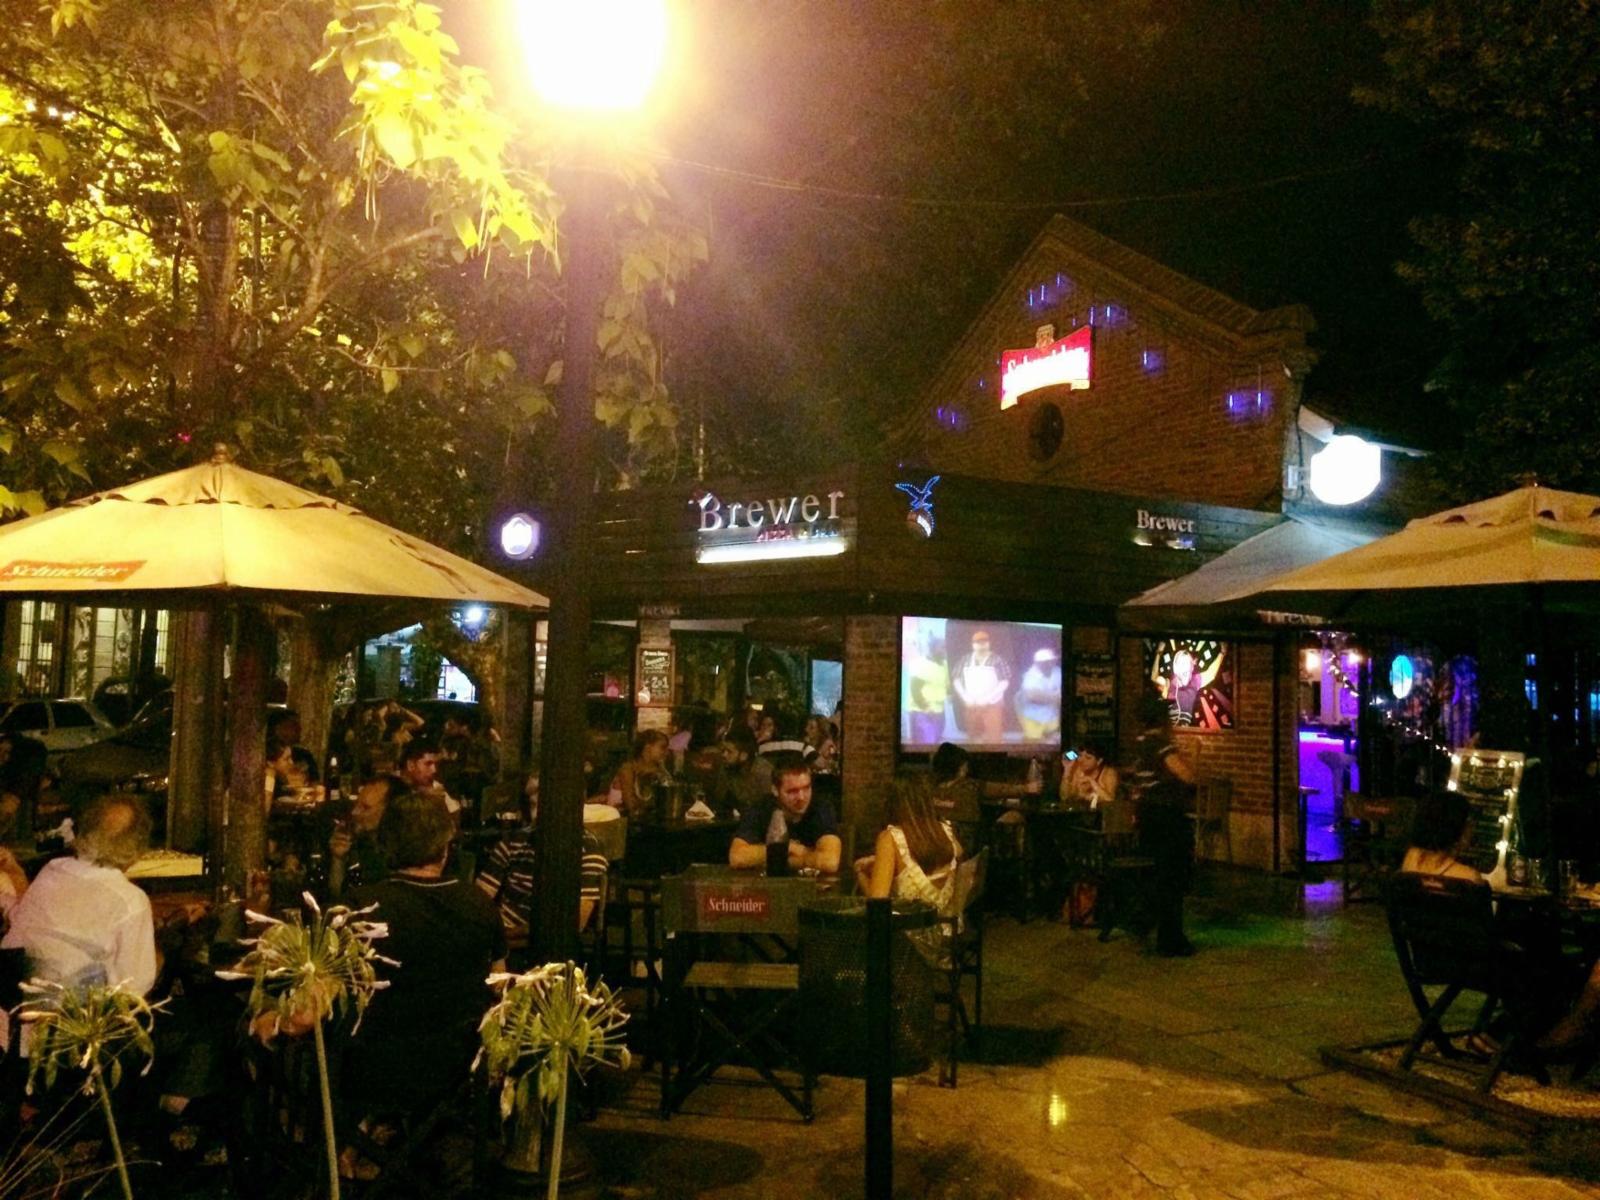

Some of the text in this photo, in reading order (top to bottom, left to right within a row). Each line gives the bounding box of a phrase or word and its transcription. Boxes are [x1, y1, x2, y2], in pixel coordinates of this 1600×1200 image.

[697, 490, 844, 532] Brewer
[1136, 509, 1195, 533] Brewer
[708, 898, 767, 913] Schneider
